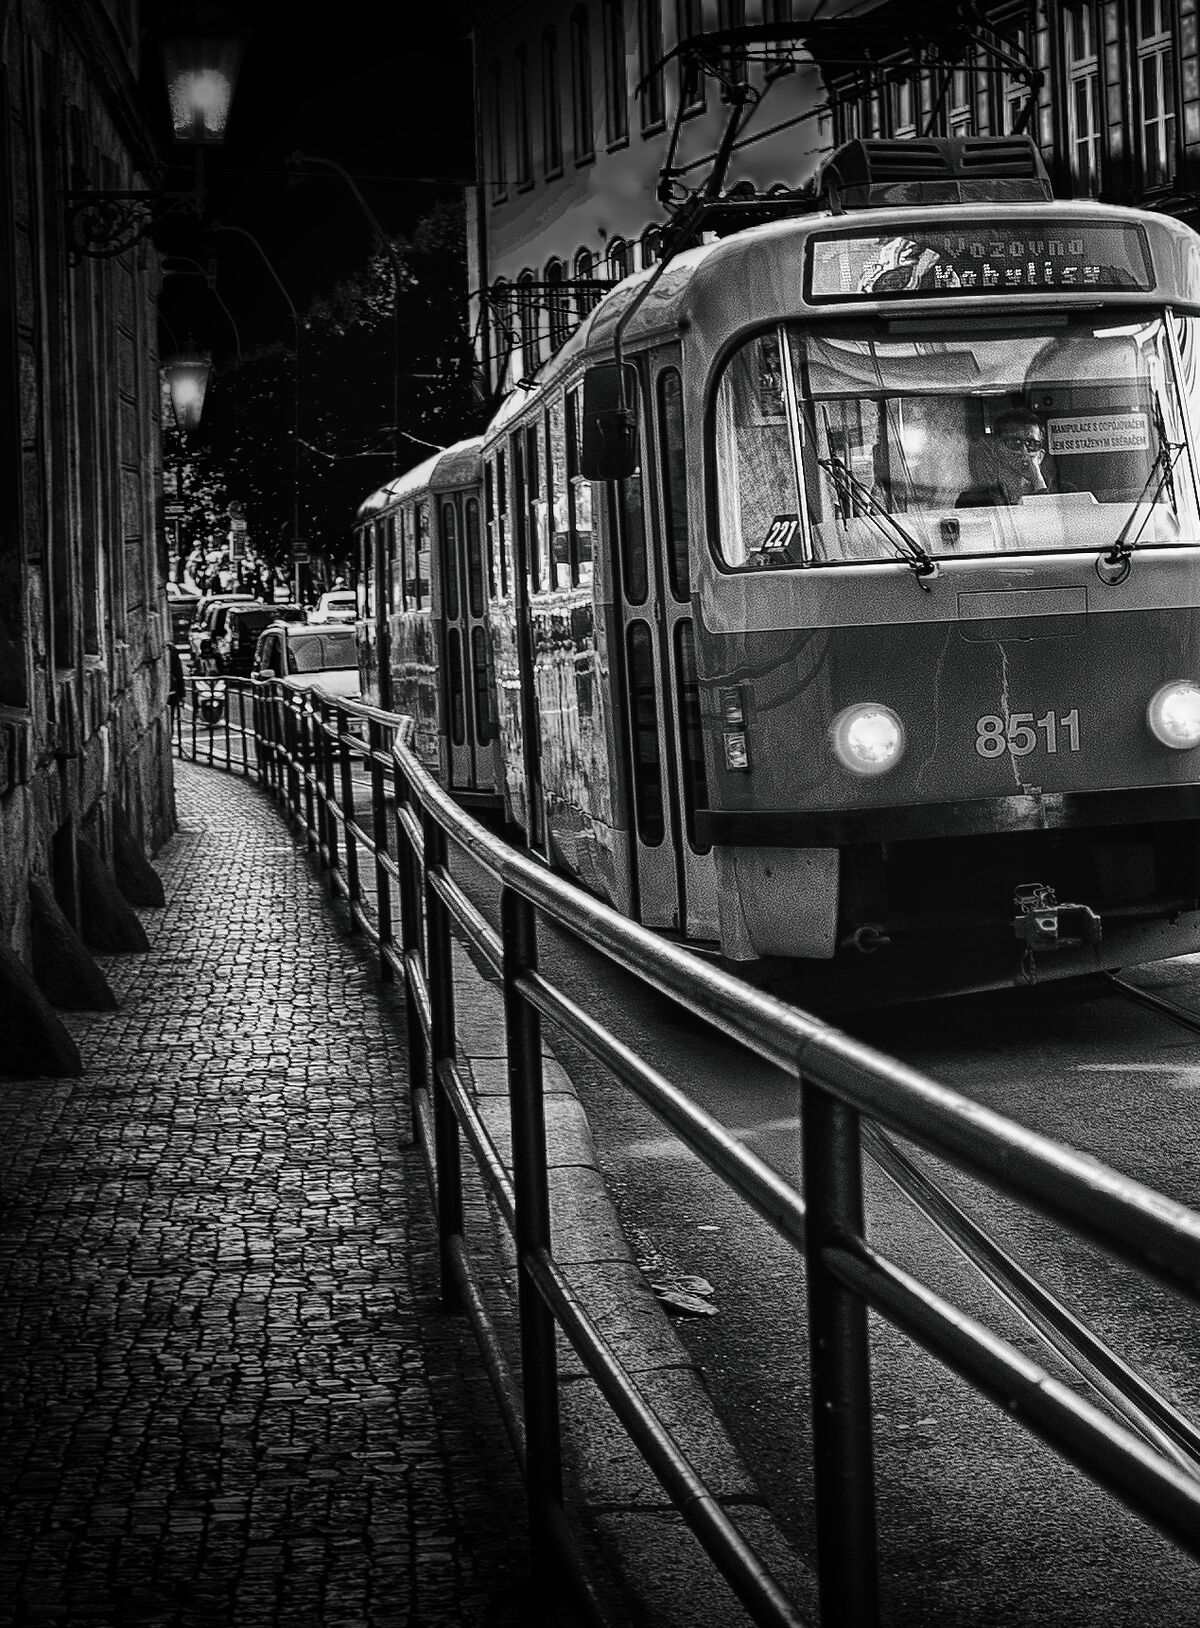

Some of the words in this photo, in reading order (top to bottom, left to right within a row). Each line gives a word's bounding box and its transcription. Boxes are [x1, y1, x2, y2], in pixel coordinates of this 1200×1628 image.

[944, 237, 1083, 258] Vozovna
[764, 521, 798, 547] 221
[975, 709, 1080, 758] 8511
